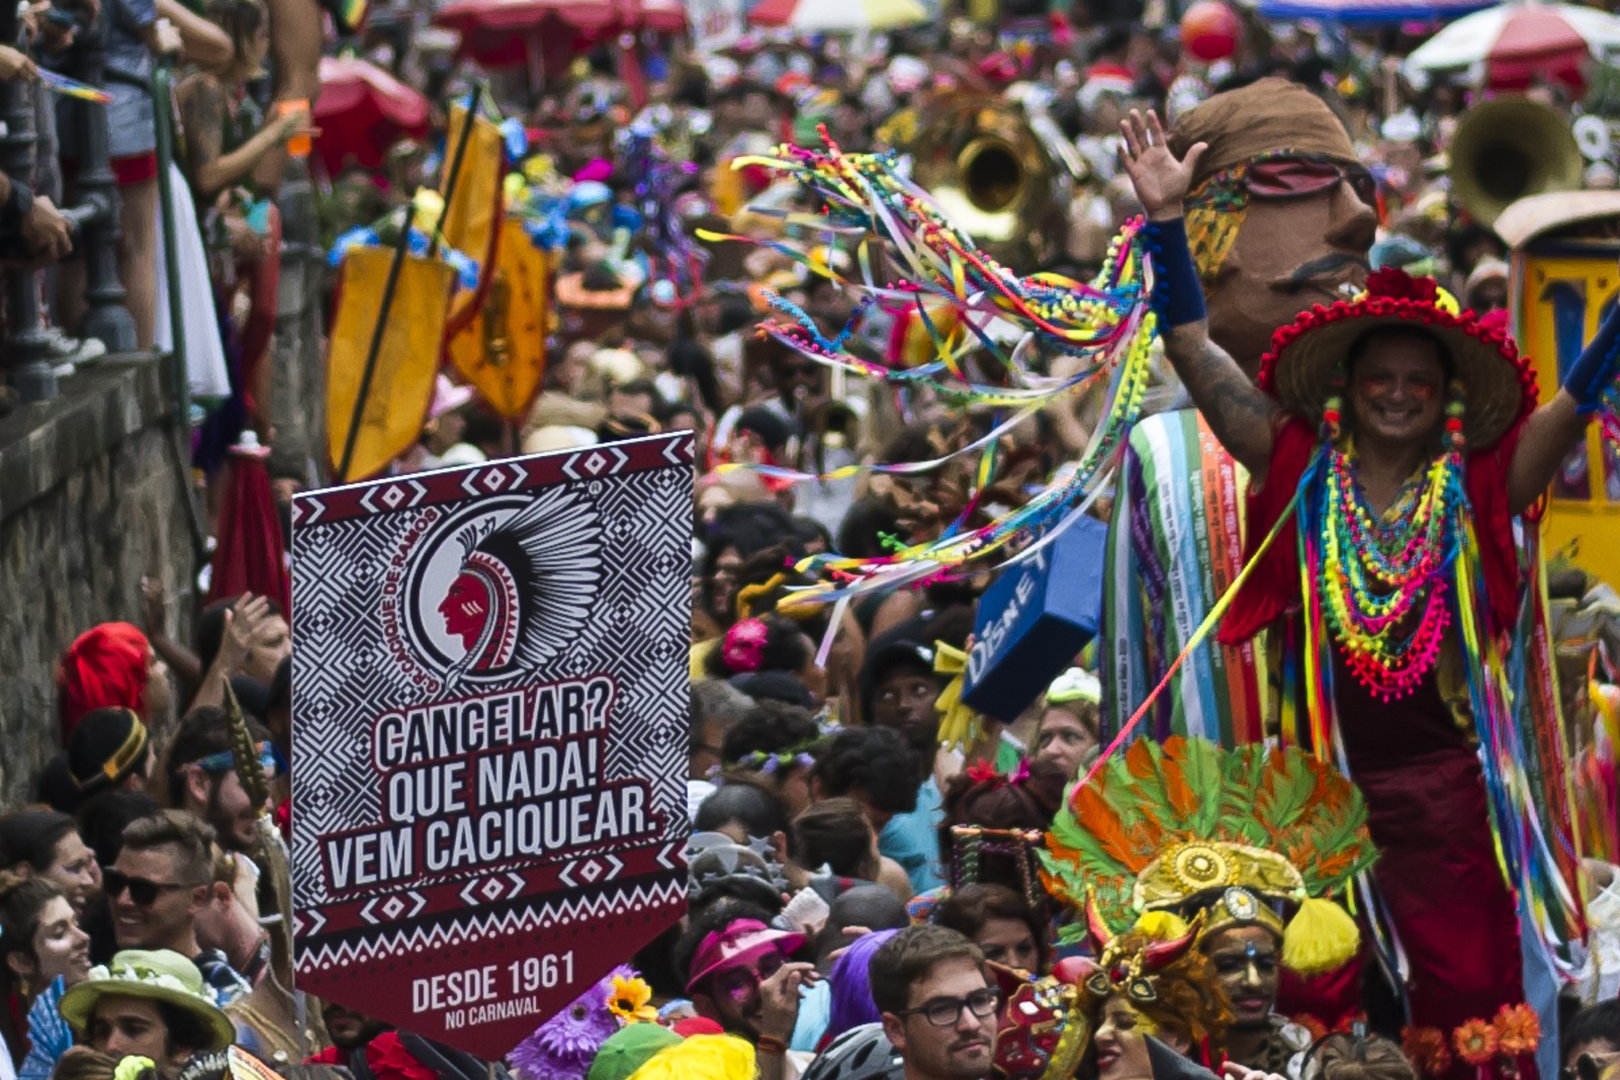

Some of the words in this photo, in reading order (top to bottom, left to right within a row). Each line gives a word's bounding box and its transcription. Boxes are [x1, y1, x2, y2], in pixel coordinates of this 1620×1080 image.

[391, 507, 438, 568] RAMOS
[376, 678, 614, 771] CANCELAR?
[389, 762, 466, 821] QUE
[478, 737, 598, 807] NADA!
[327, 827, 413, 889] VEM
[426, 785, 656, 872] CACIQUEAR.
[412, 964, 498, 1013] DESDE
[507, 950, 575, 993] 1961
[445, 1010, 466, 1030] NO
[468, 997, 541, 1026] CARNAVAL
